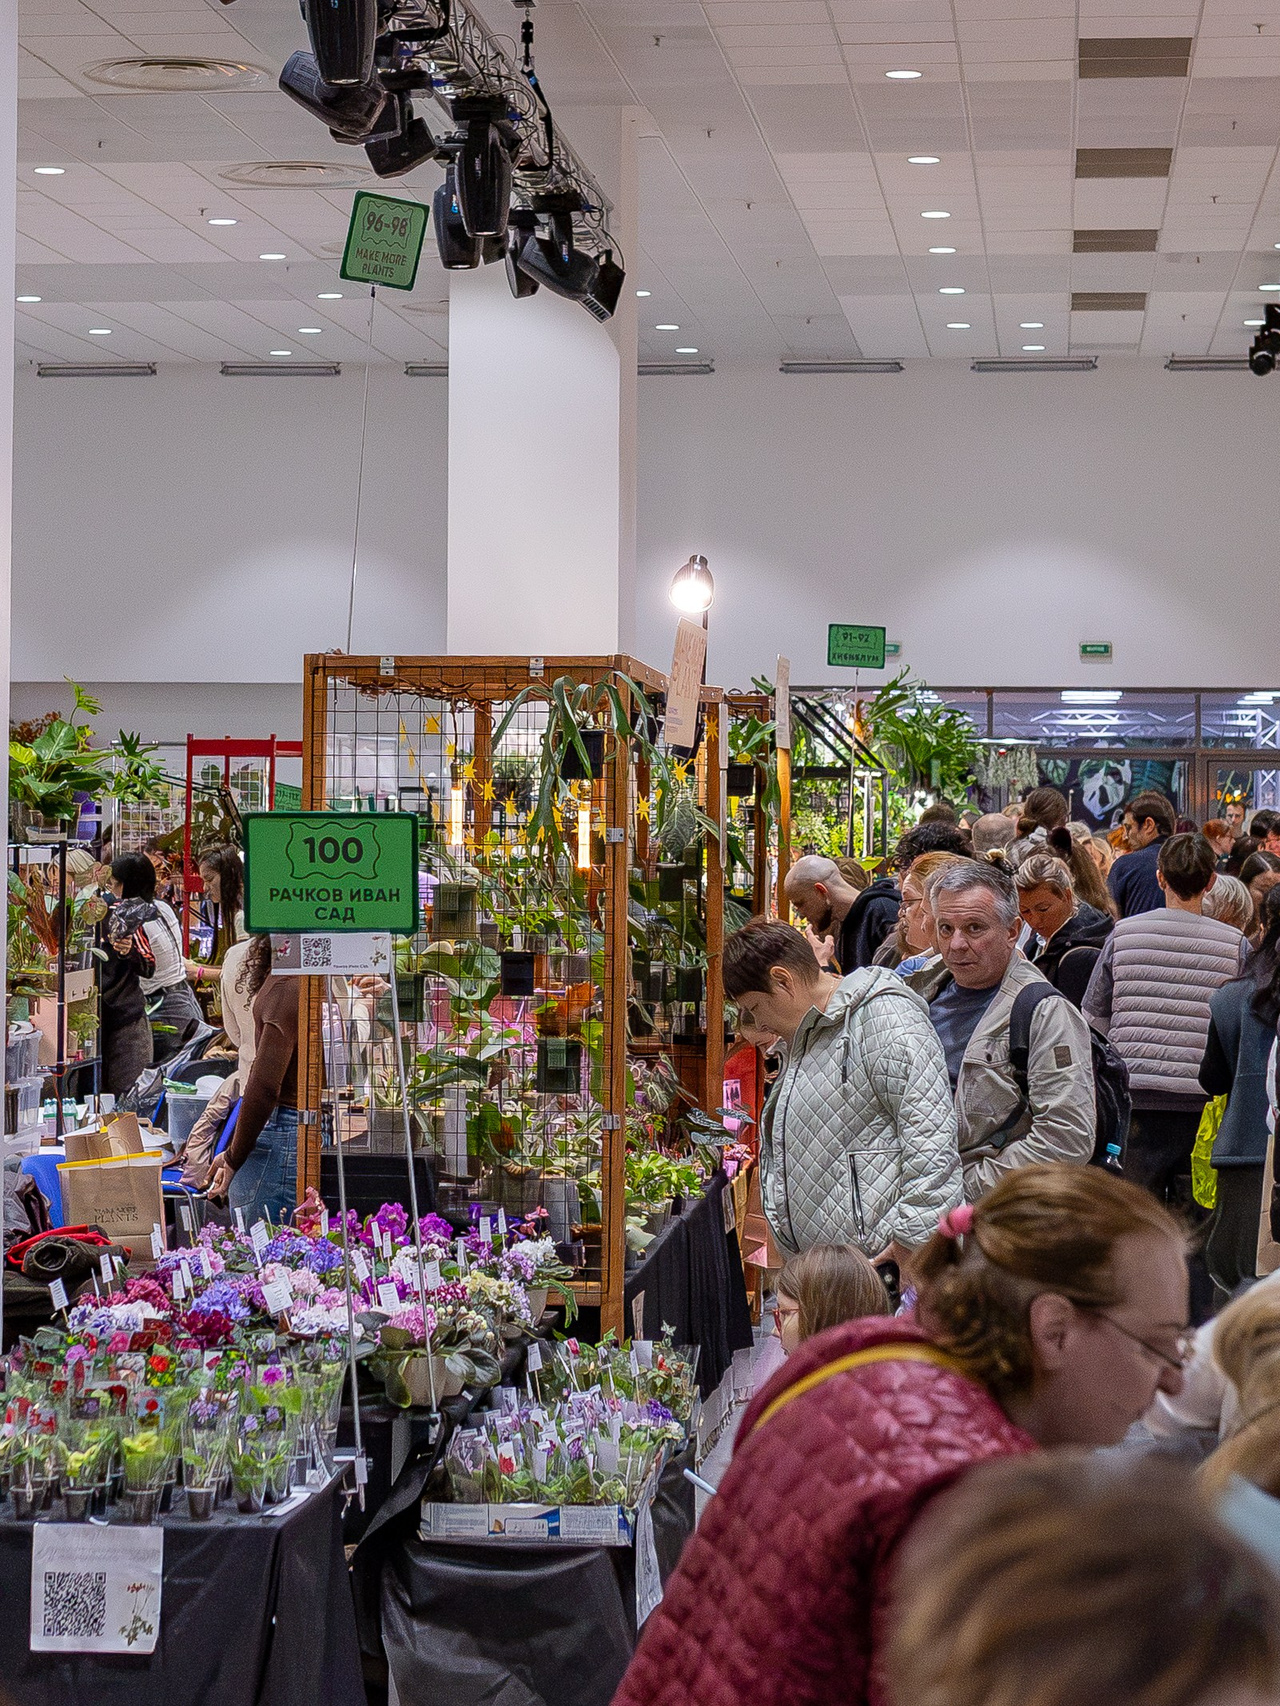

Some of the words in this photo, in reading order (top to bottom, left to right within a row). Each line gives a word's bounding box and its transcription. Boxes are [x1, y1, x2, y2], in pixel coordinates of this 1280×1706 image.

[366, 211, 408, 237] 96-98
[355, 247, 381, 262] MAKE
[381, 251, 408, 266] MORE
[361, 263, 394, 278] PLANTS
[303, 836, 364, 864] 100
[269, 887, 343, 903] РАЧКОВ
[350, 887, 401, 903] ИВАН
[314, 906, 356, 924] САД
